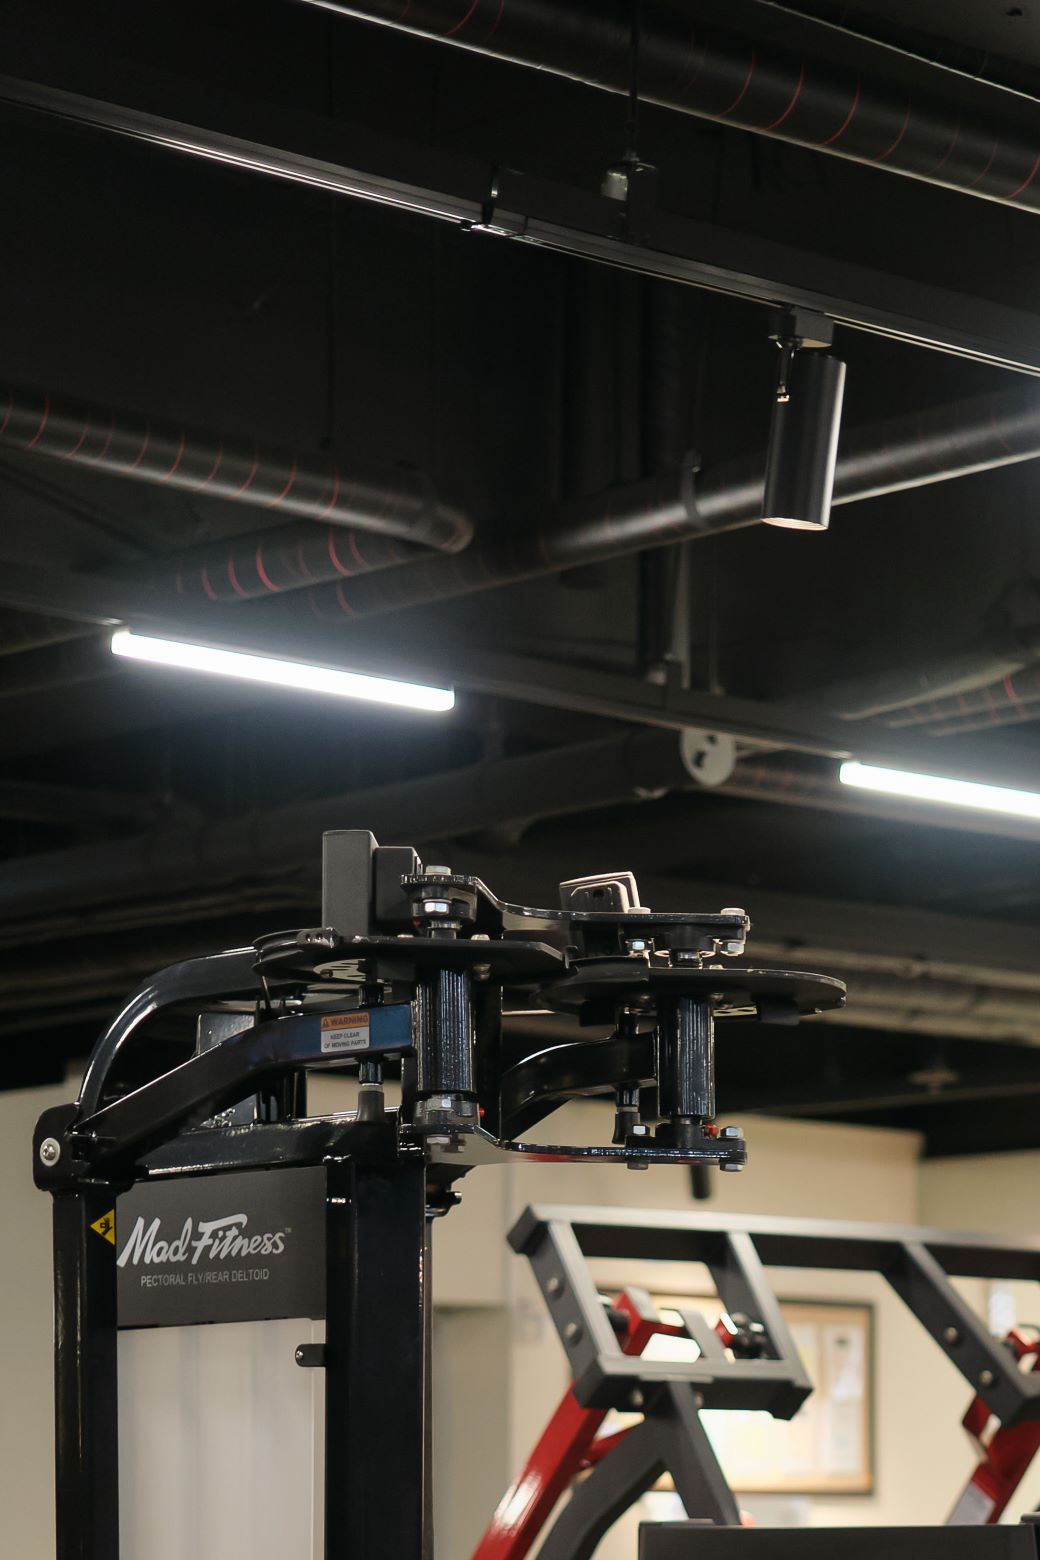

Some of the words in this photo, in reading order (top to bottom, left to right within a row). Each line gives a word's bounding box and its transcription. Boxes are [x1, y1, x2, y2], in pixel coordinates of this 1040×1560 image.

[331, 1014, 369, 1026] WARNING
[116, 1216, 193, 1267] Mad
[191, 1213, 286, 1265] Fitness
[140, 1273, 186, 1288] PECTORAL
[187, 1270, 230, 1285] FLY/REAR
[231, 1268, 270, 1282] DELTOID
